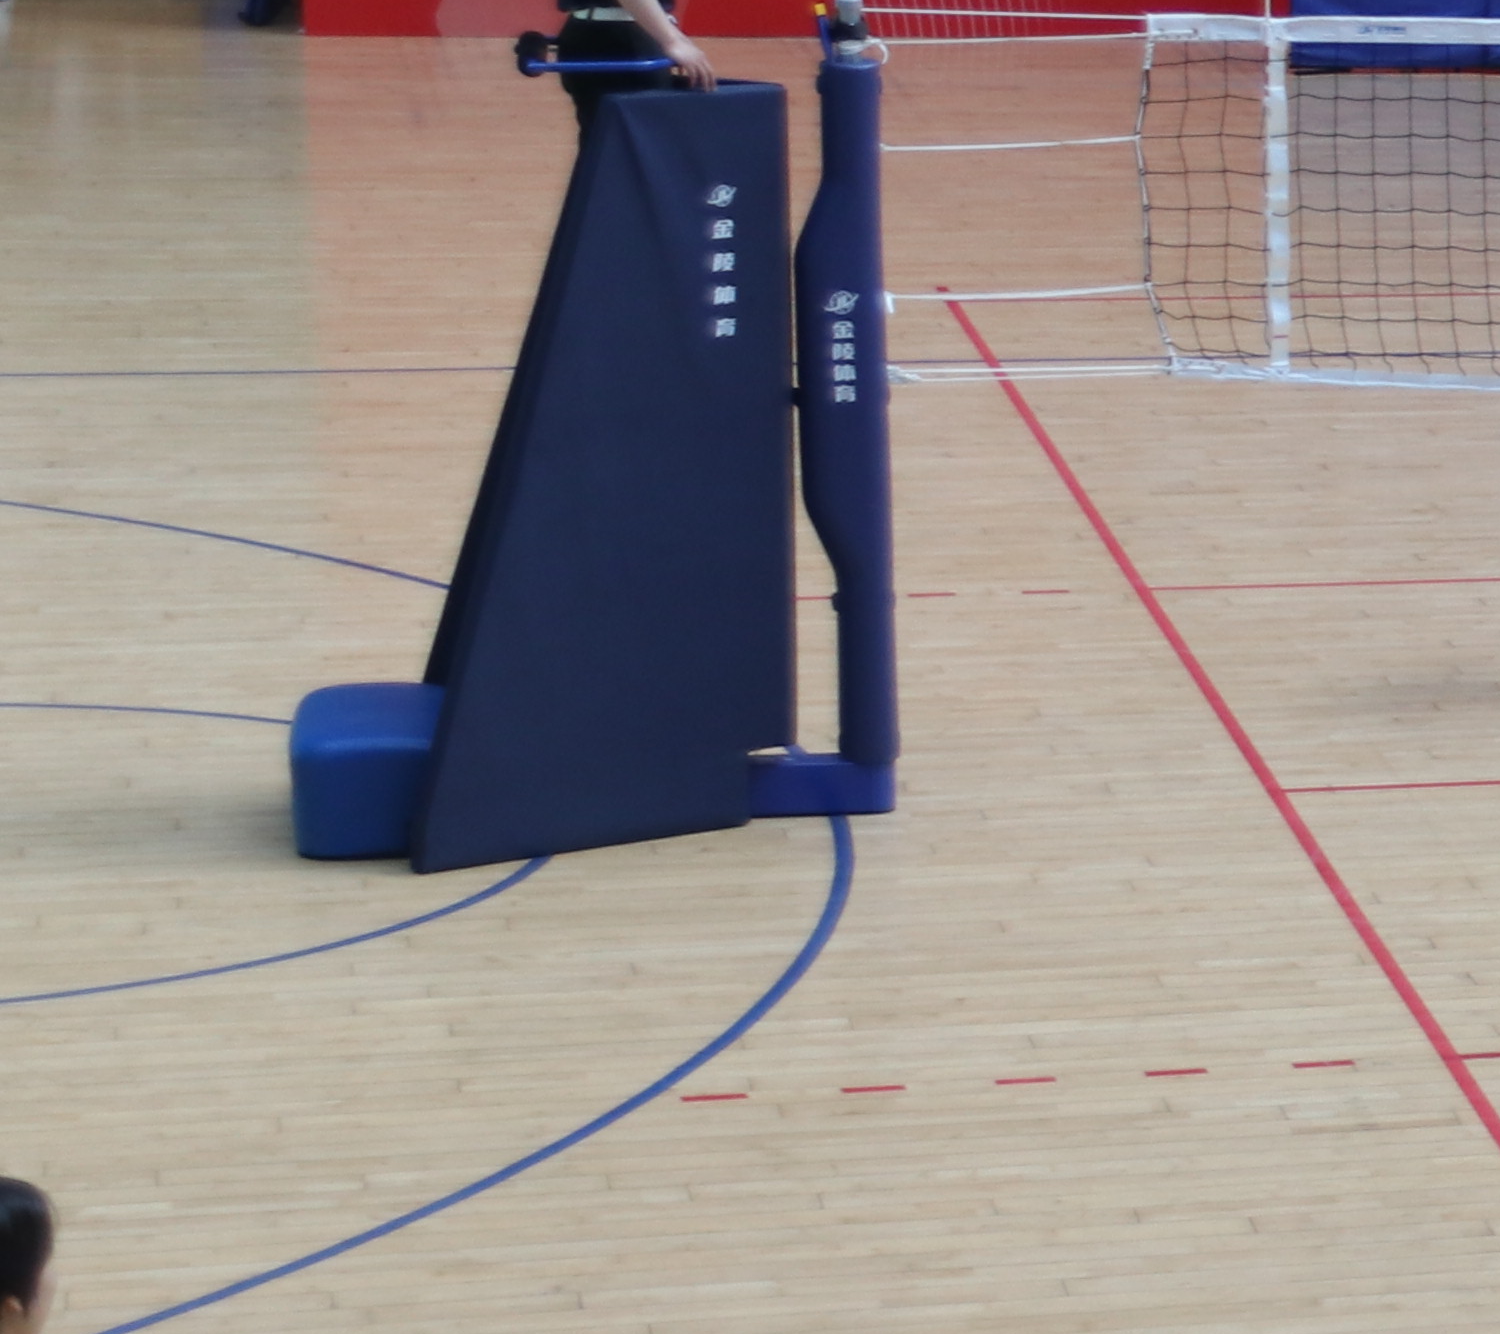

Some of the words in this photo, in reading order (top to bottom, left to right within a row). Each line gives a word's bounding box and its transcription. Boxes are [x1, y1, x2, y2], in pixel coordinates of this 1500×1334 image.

[711, 219, 738, 337] 金陵体育
[831, 320, 857, 403] 金陵体育
